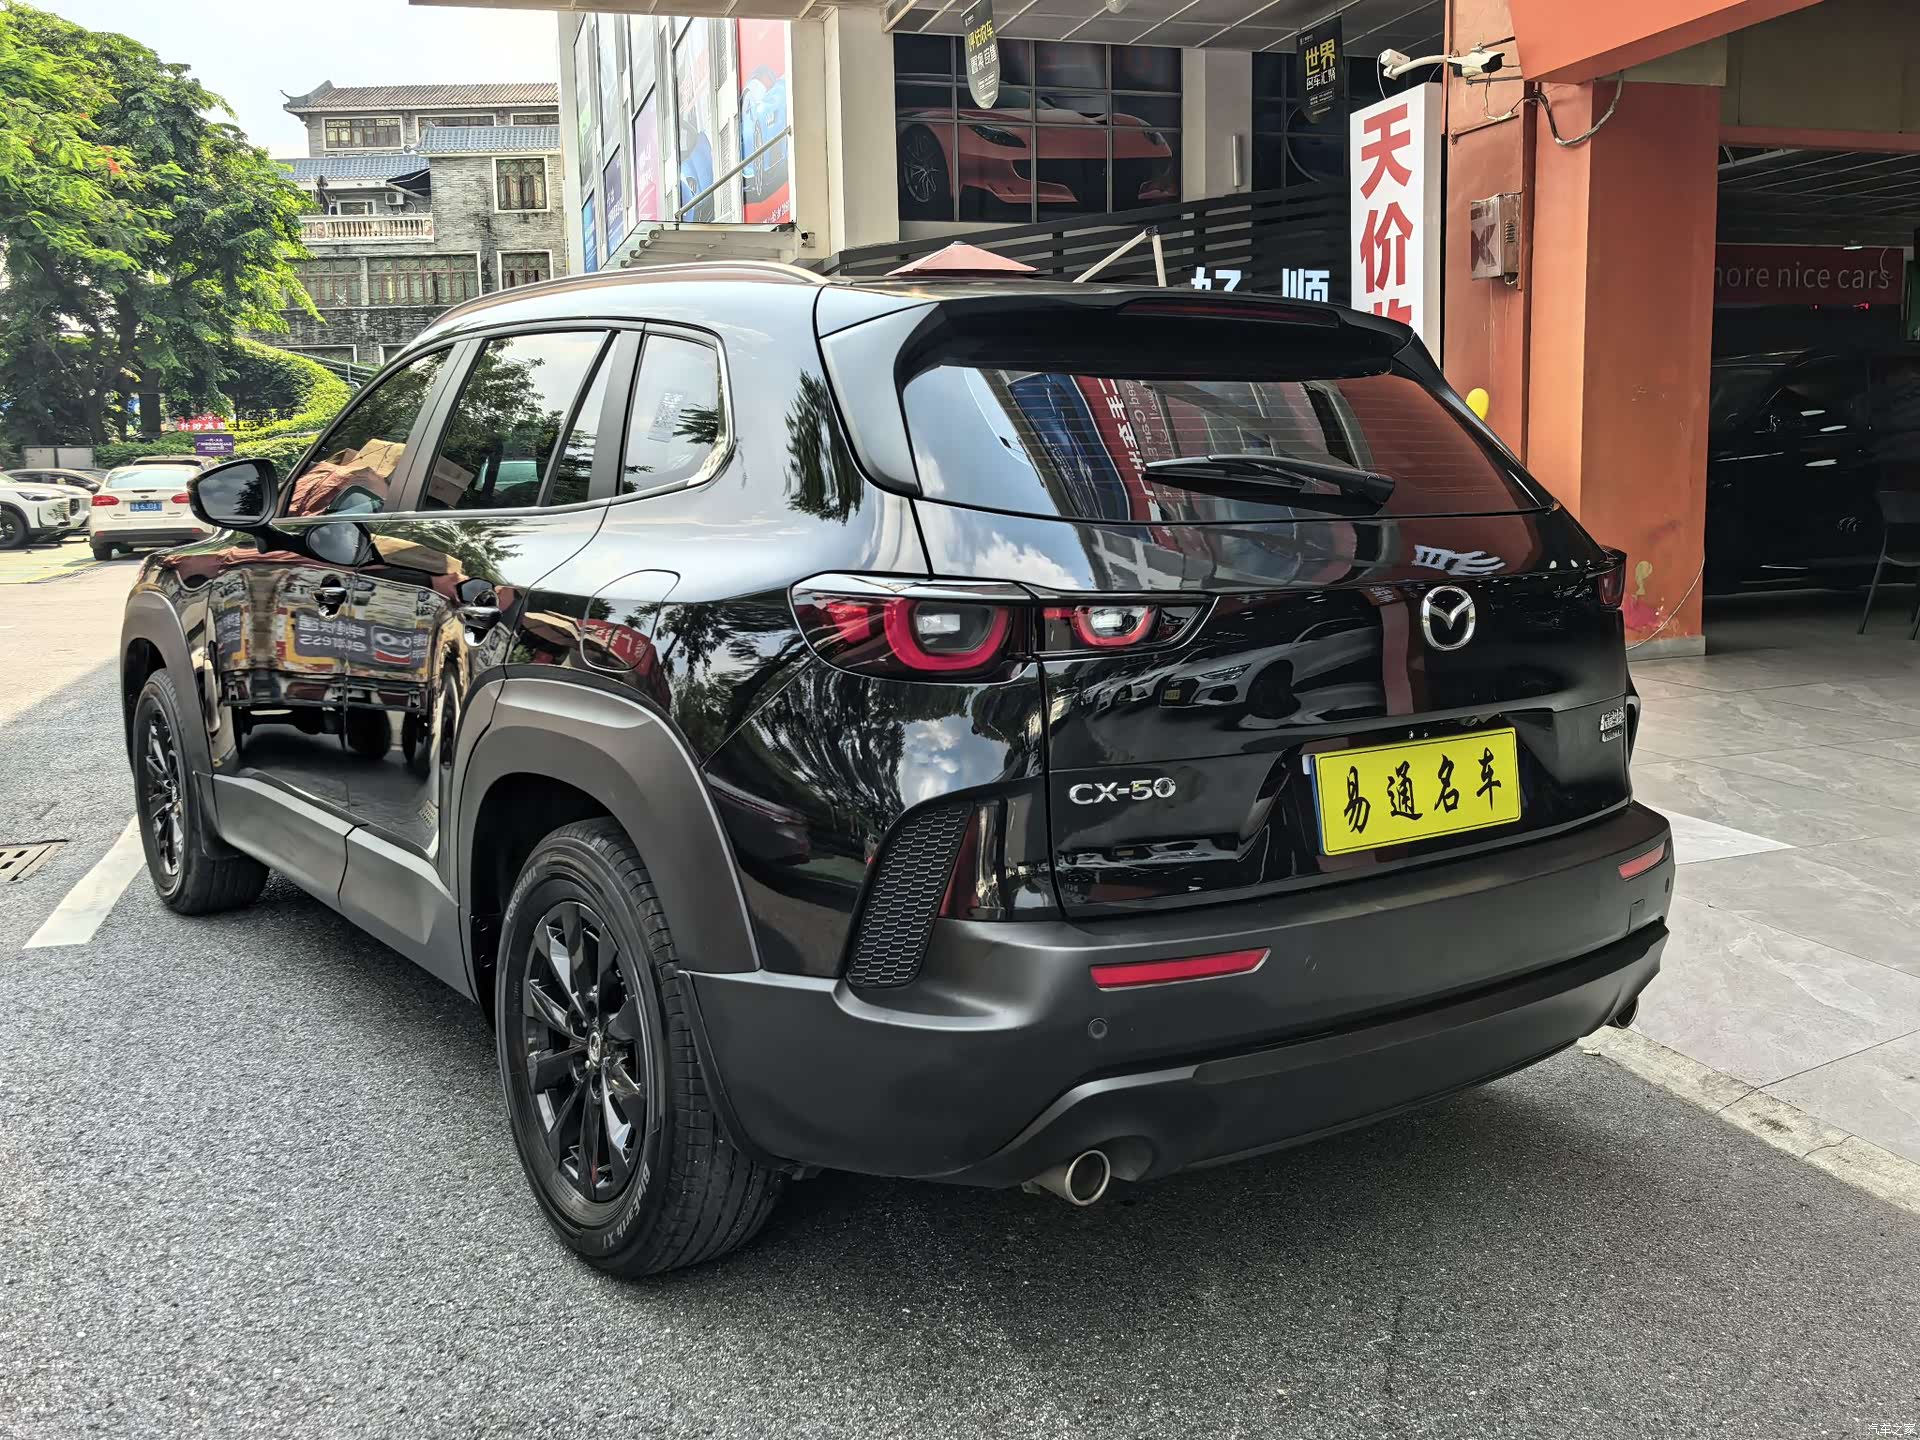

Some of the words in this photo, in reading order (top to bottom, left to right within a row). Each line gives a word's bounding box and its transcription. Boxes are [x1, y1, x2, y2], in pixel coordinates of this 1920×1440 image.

[1305, 38, 1336, 77] 世界
[1359, 102, 1414, 326] 天价
[1777, 260, 1831, 288] nice
[1837, 268, 1892, 289] cars
[1069, 777, 1177, 805] CX-50
[1343, 746, 1502, 834] 易通名车
